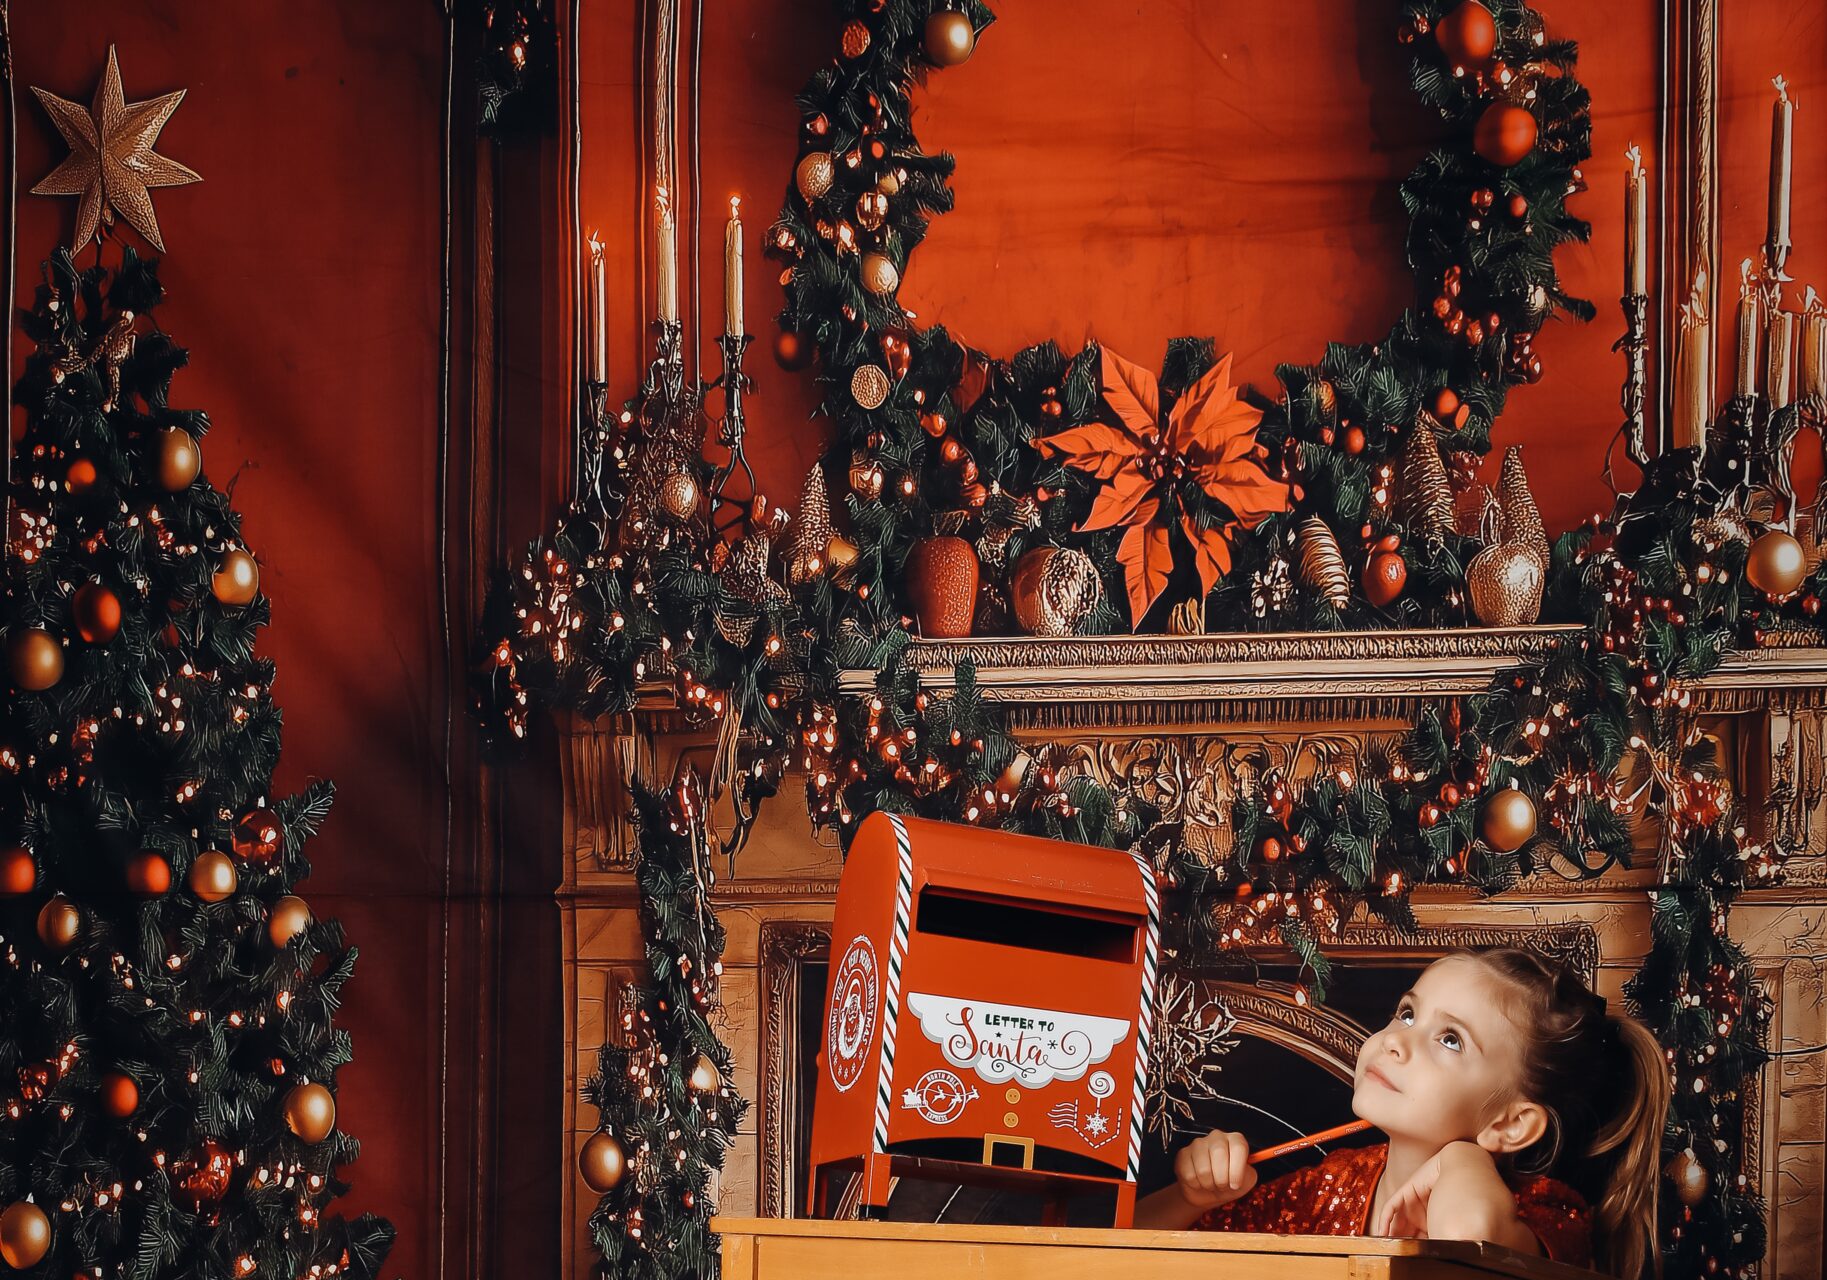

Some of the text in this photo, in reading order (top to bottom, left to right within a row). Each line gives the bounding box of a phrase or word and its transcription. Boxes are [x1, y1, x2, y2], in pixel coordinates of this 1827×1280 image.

[835, 977, 844, 1002] YOU
[864, 976, 875, 1045] CHRISTMAS
[984, 1013, 1055, 1033] LETTER TO
[945, 1006, 1092, 1071] Santa
[927, 1073, 959, 1087] NORTH POLE
[926, 1111, 948, 1121] EXPRESS
